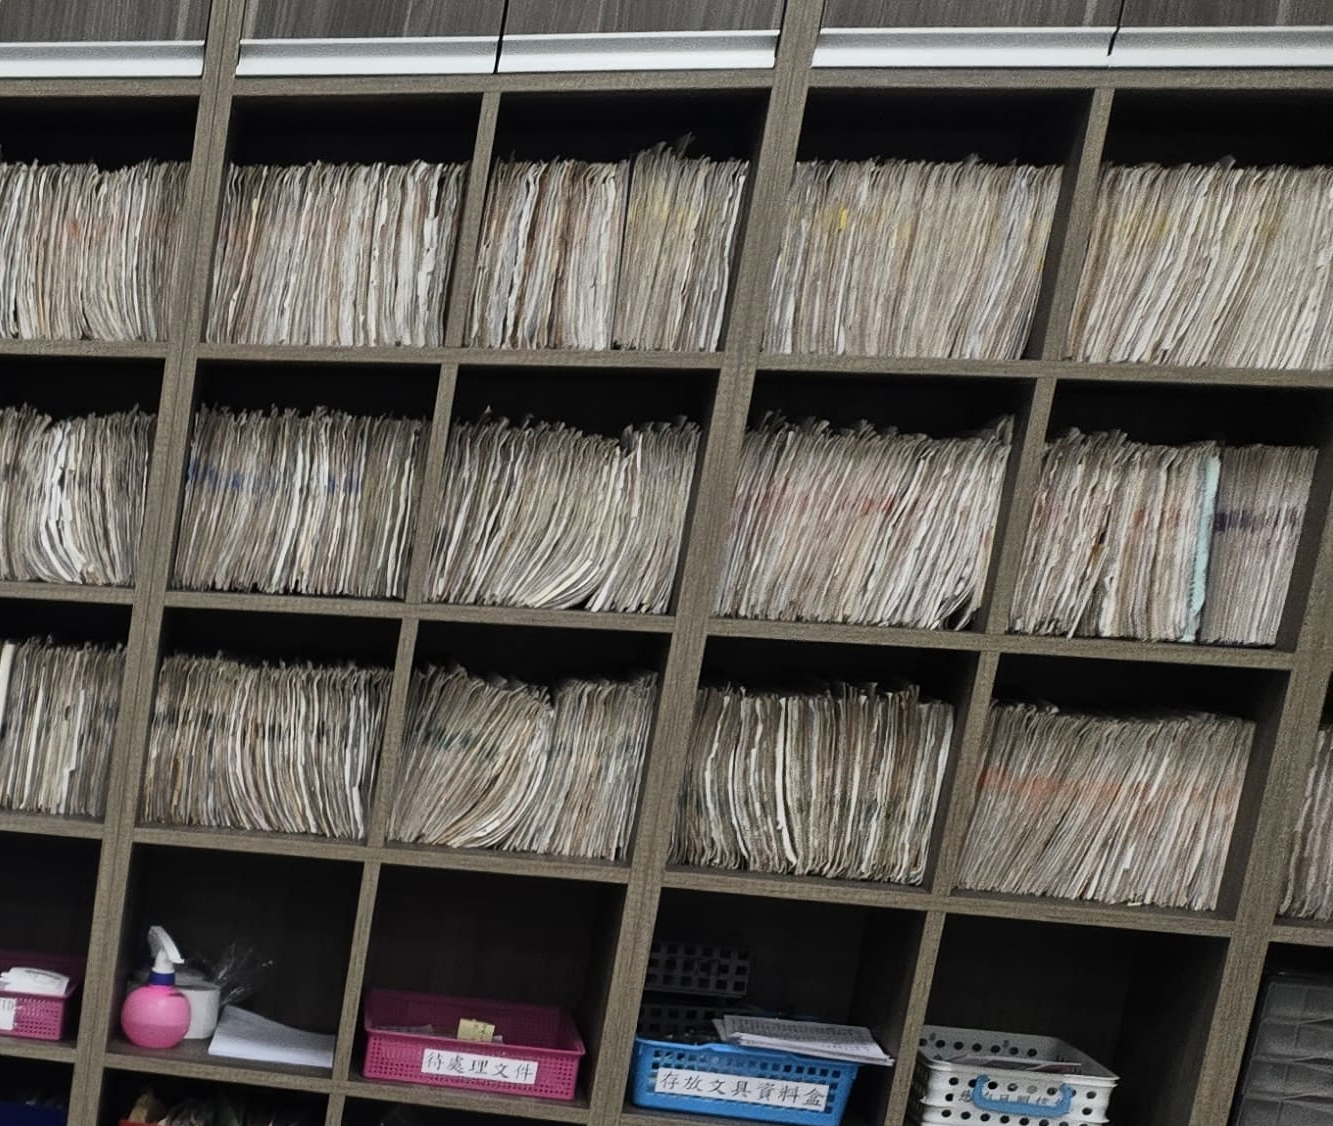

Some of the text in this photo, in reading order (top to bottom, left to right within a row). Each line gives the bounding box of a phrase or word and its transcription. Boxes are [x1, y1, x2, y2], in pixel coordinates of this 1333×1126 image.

[427, 1052, 533, 1081] 待處理文件
[661, 1071, 824, 1107] 存放文具資料盒
